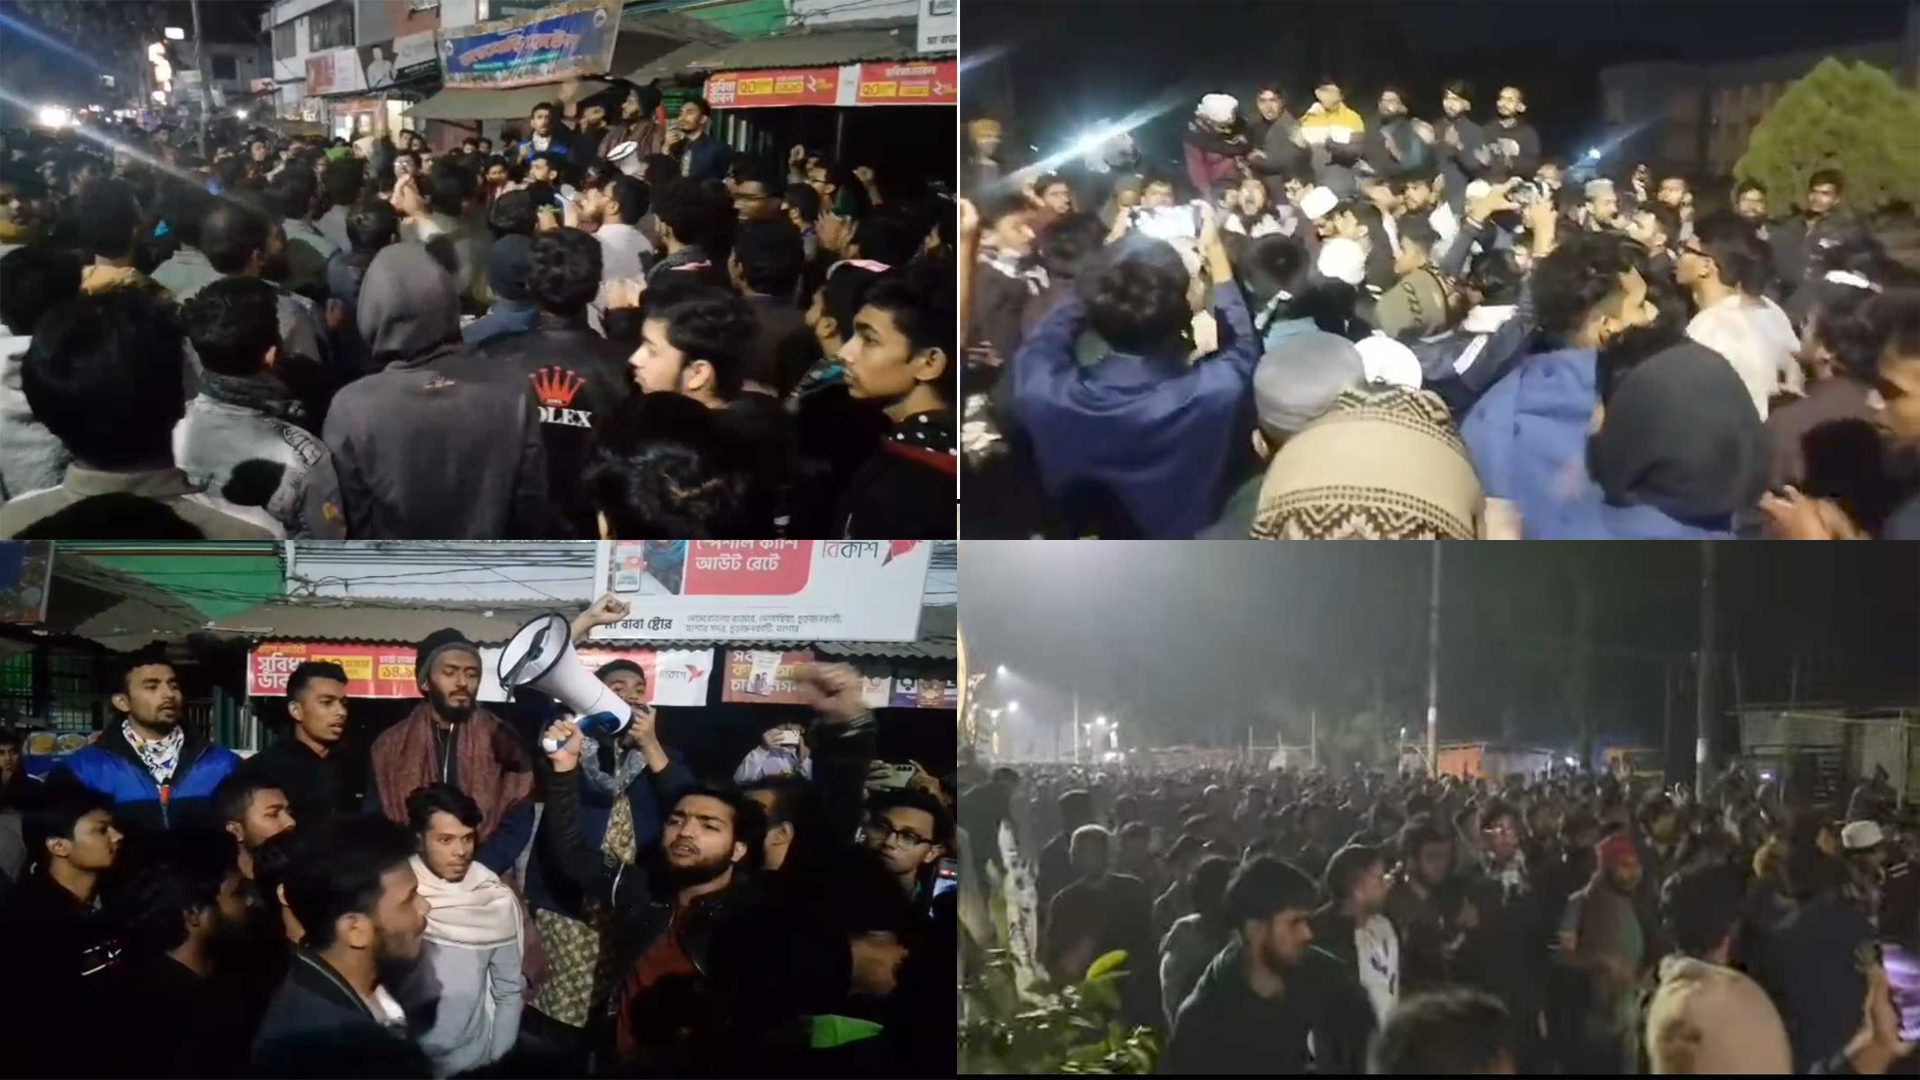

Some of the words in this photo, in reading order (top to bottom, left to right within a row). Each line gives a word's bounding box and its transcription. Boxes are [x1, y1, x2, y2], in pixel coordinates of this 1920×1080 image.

[696, 554, 743, 571] আউট
[621, 618, 645, 630] বাবা
[257, 673, 290, 688] ডাব
